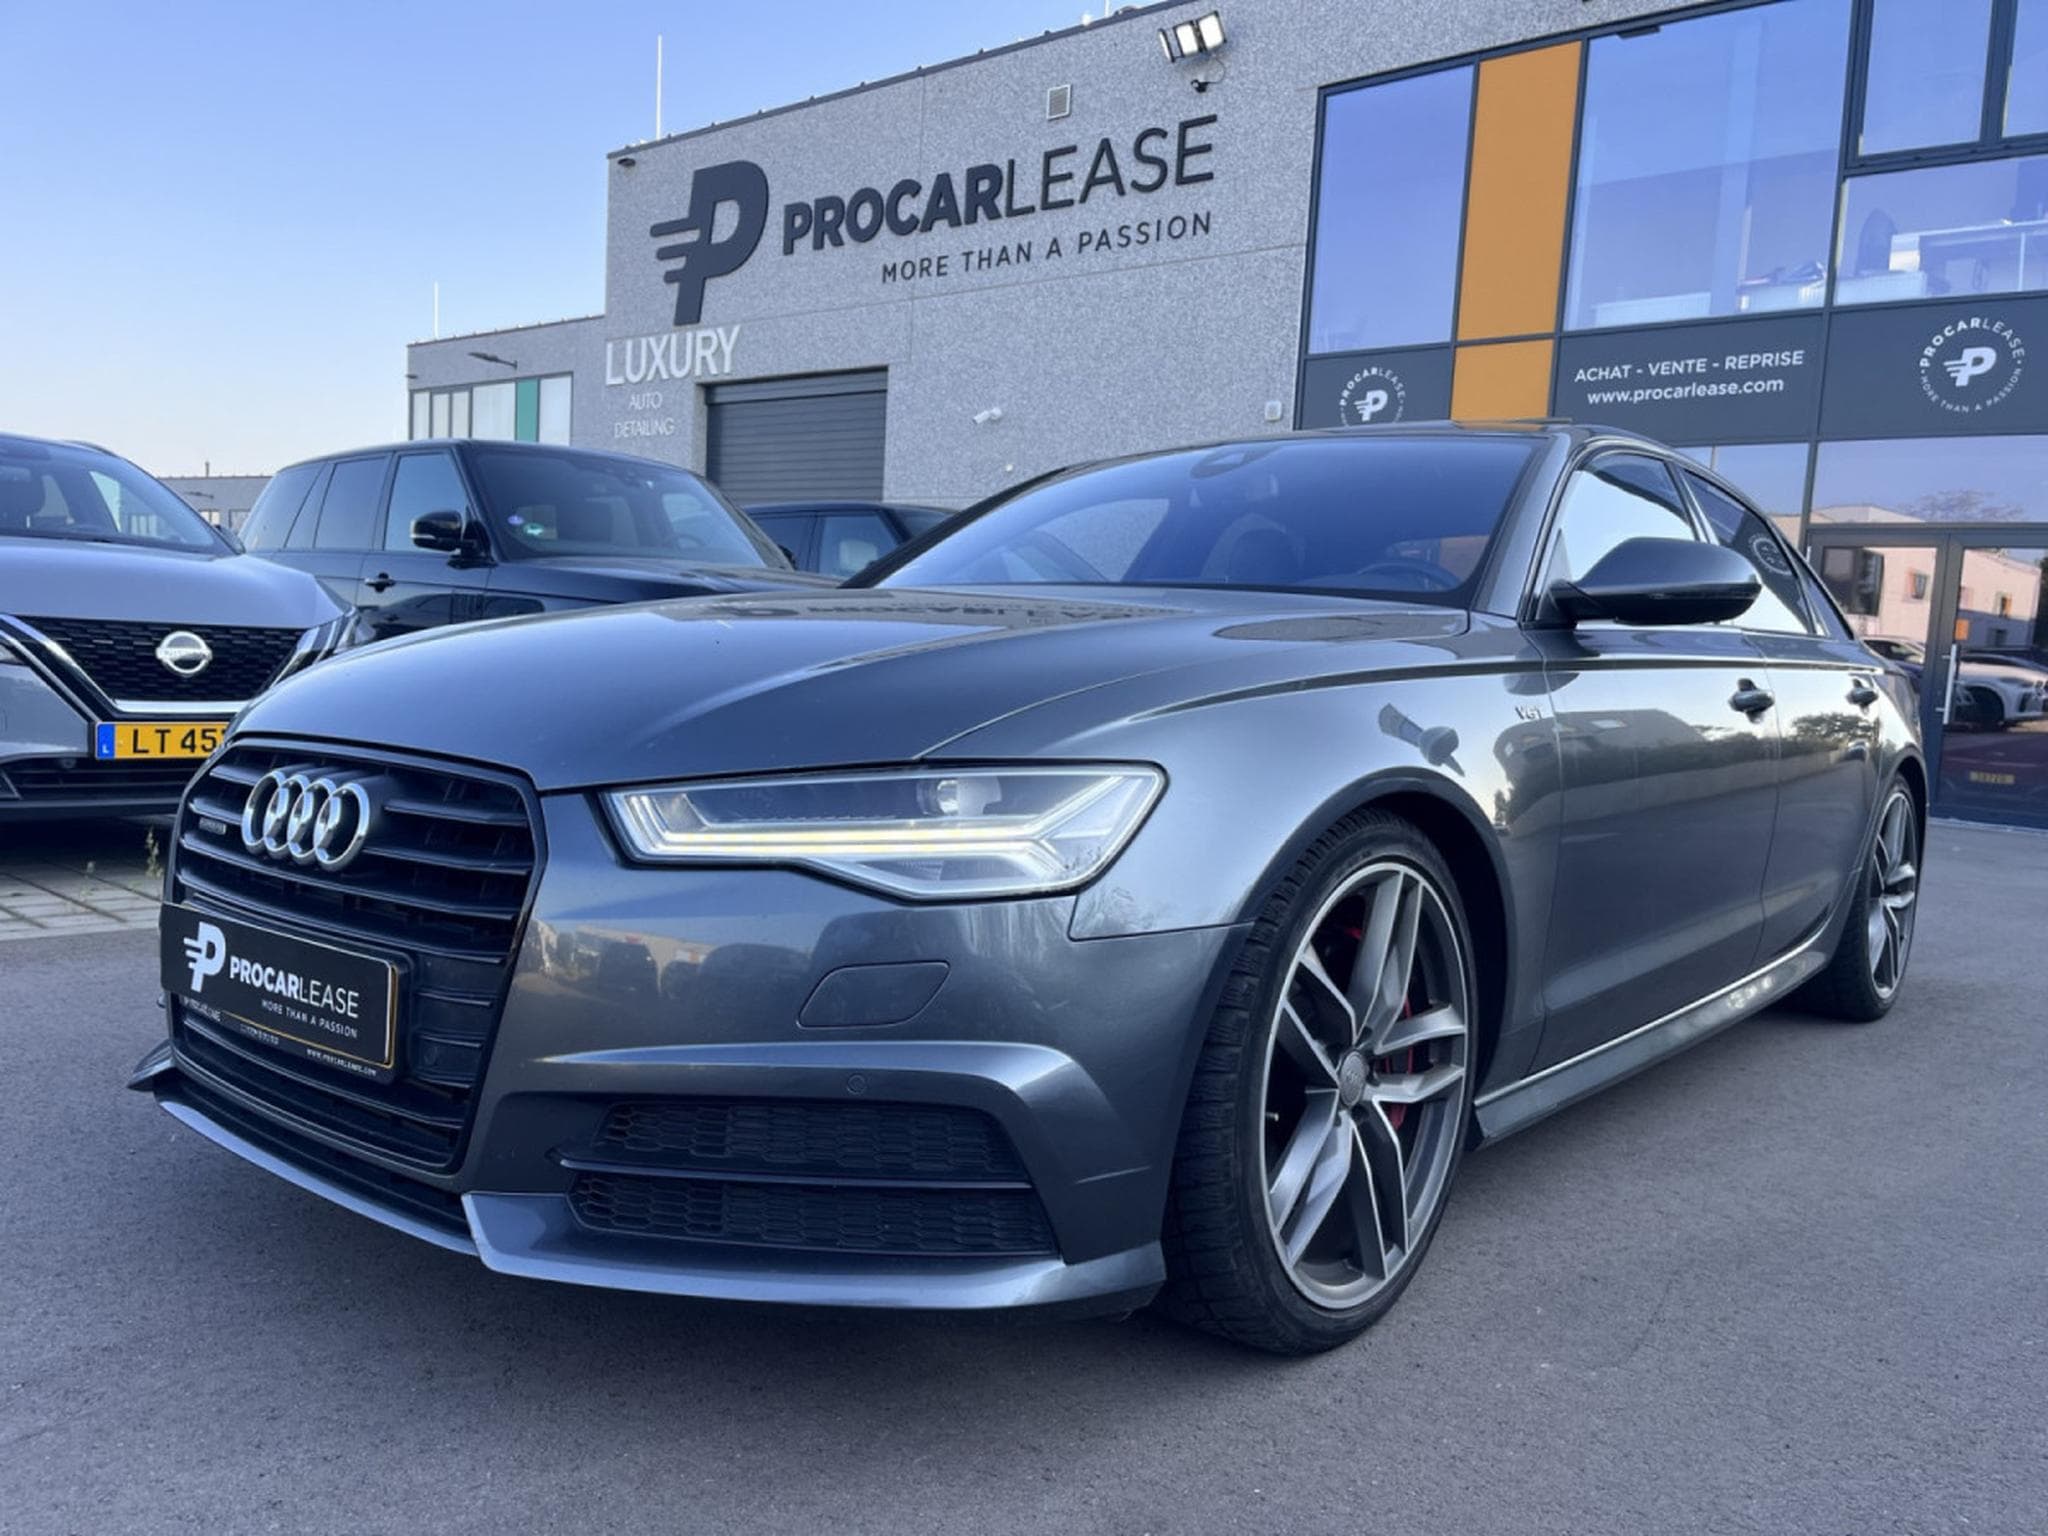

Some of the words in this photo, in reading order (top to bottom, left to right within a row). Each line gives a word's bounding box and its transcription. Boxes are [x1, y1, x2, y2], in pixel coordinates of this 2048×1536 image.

[783, 114, 1217, 256] PROCARLEASE
[881, 255, 949, 283] MORE
[962, 241, 1032, 272] THAN
[1045, 238, 1063, 258] A
[1077, 211, 1211, 254] PASSION
[605, 324, 741, 386] LUXURY
[1919, 317, 2025, 368] PROCARLEASE
[1574, 364, 1632, 382] ACHAT
[1649, 358, 1707, 376] VENTE
[1724, 350, 1804, 370] REPRISE
[628, 391, 663, 410] AUTO
[1587, 378, 1784, 404] www.procarlease.com
[614, 417, 675, 438] DETAILING
[180, 728, 225, 753] 45
[229, 955, 359, 1018] PROCARLEASE
[261, 1000, 282, 1014] MORE
[285, 1006, 308, 1022] THAN
[310, 1015, 317, 1025] A
[319, 1018, 358, 1038] PASSION
